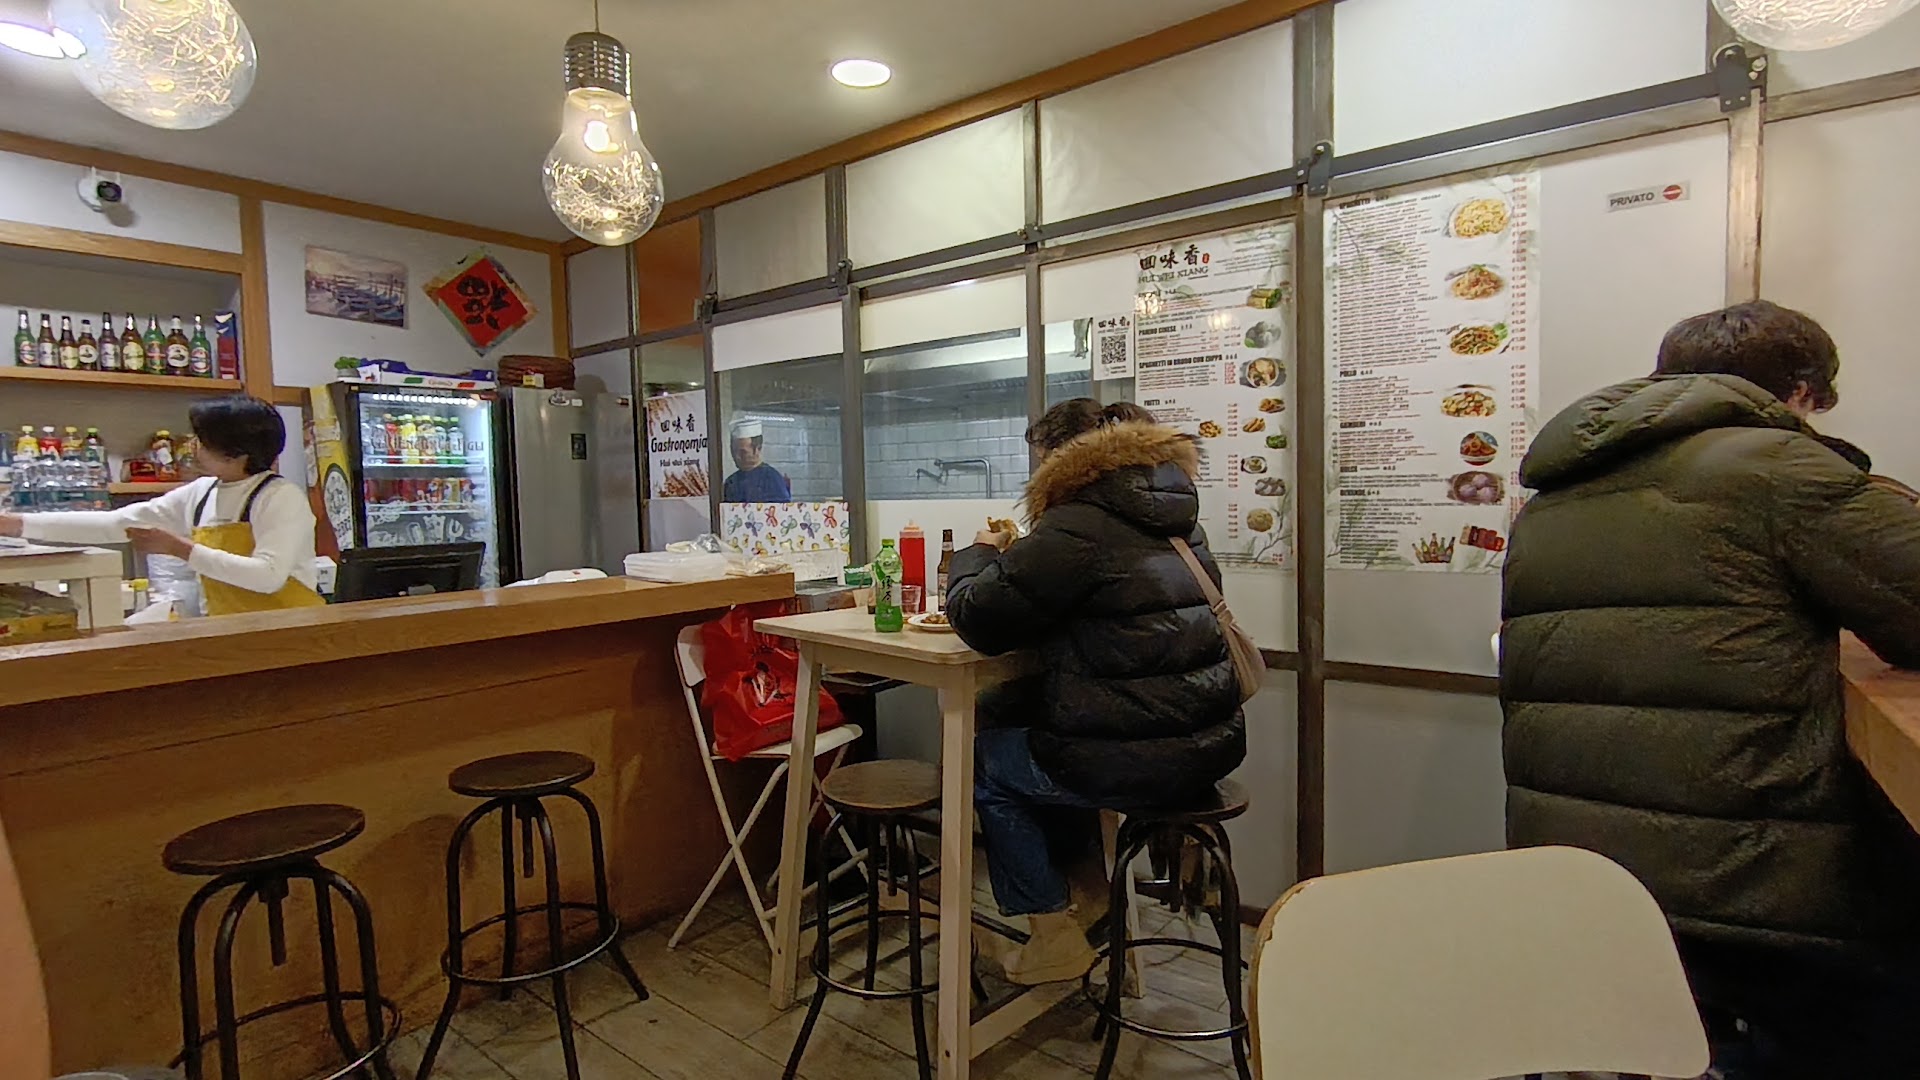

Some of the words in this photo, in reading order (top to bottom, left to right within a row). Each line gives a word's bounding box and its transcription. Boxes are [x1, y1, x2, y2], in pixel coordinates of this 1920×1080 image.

[1610, 192, 1655, 207] PRIVATO
[1177, 265, 1208, 278] XIANG
[651, 434, 708, 454] Gastronomia
